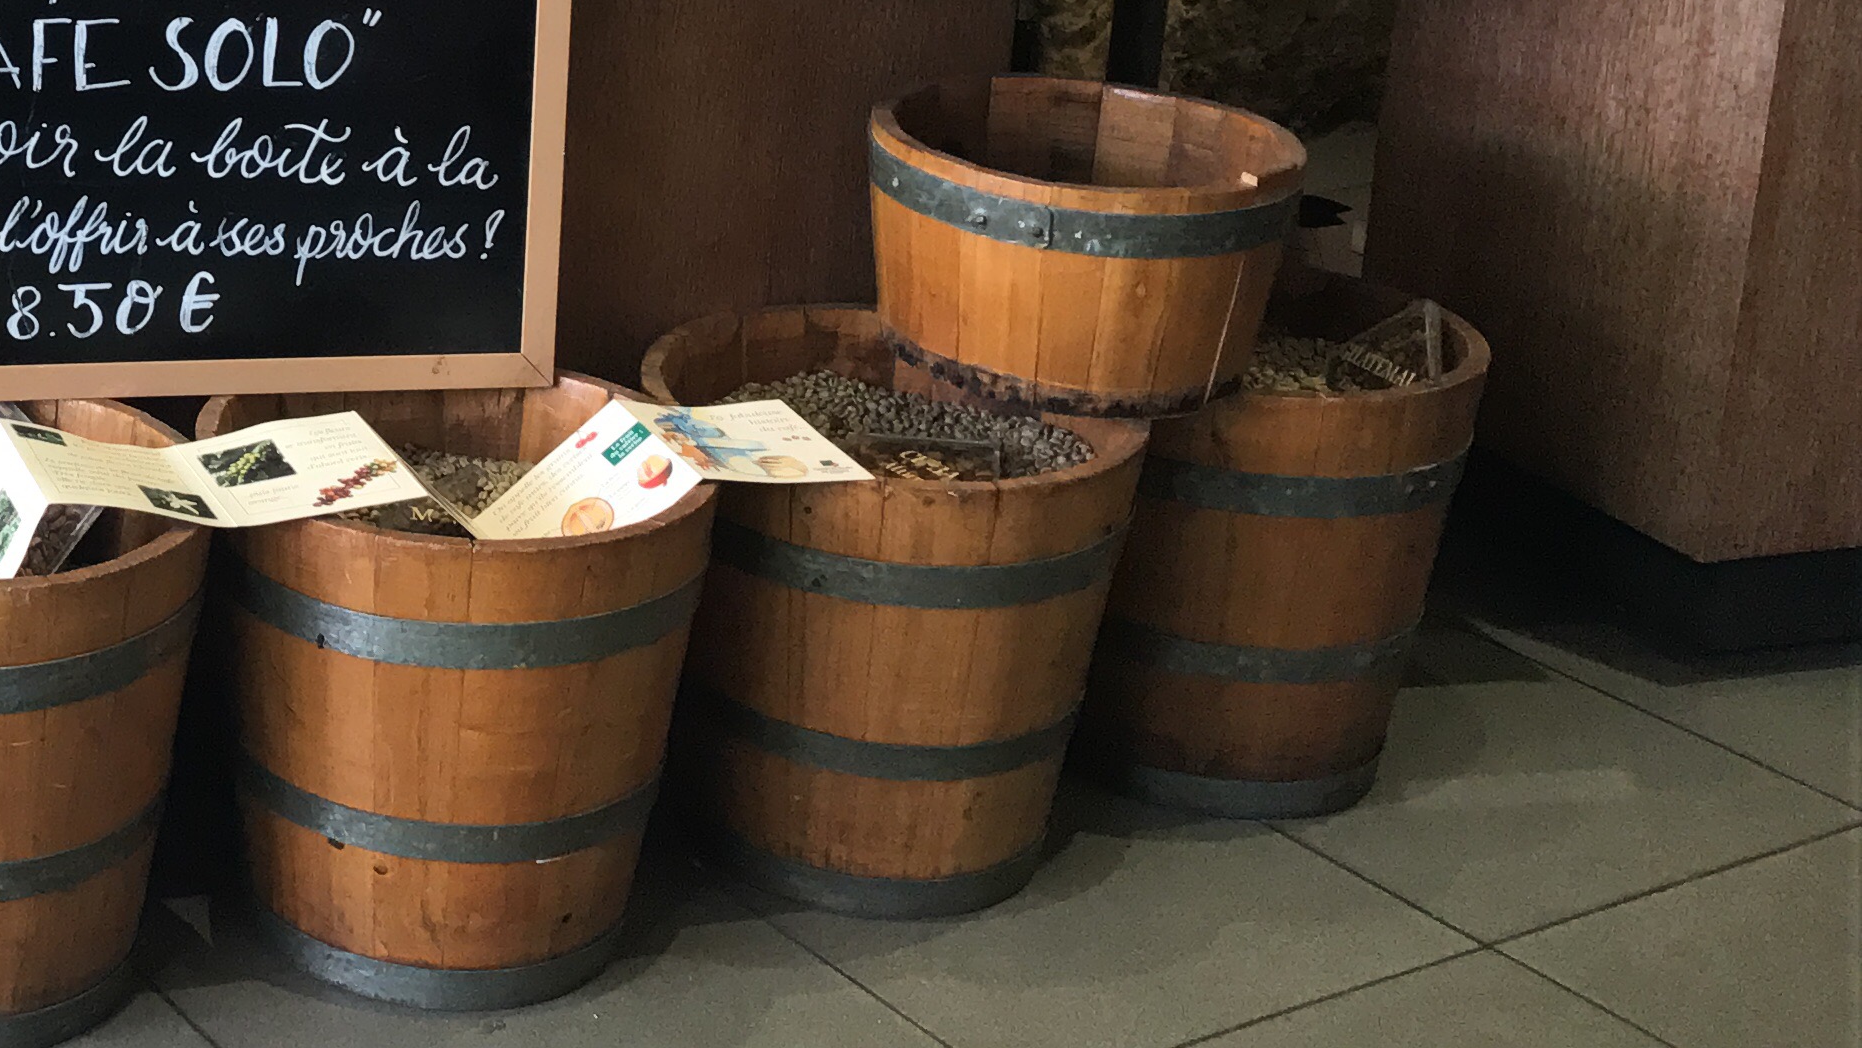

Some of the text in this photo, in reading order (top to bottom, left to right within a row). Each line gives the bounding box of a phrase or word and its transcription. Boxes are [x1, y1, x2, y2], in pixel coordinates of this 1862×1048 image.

[96, 116, 177, 178] la
[362, 126, 417, 187] à
[427, 124, 499, 190] la
[157, 199, 206, 257] à
[214, 209, 287, 259] ses
[295, 198, 469, 285] proches
[5, 279, 164, 340] 8.50
